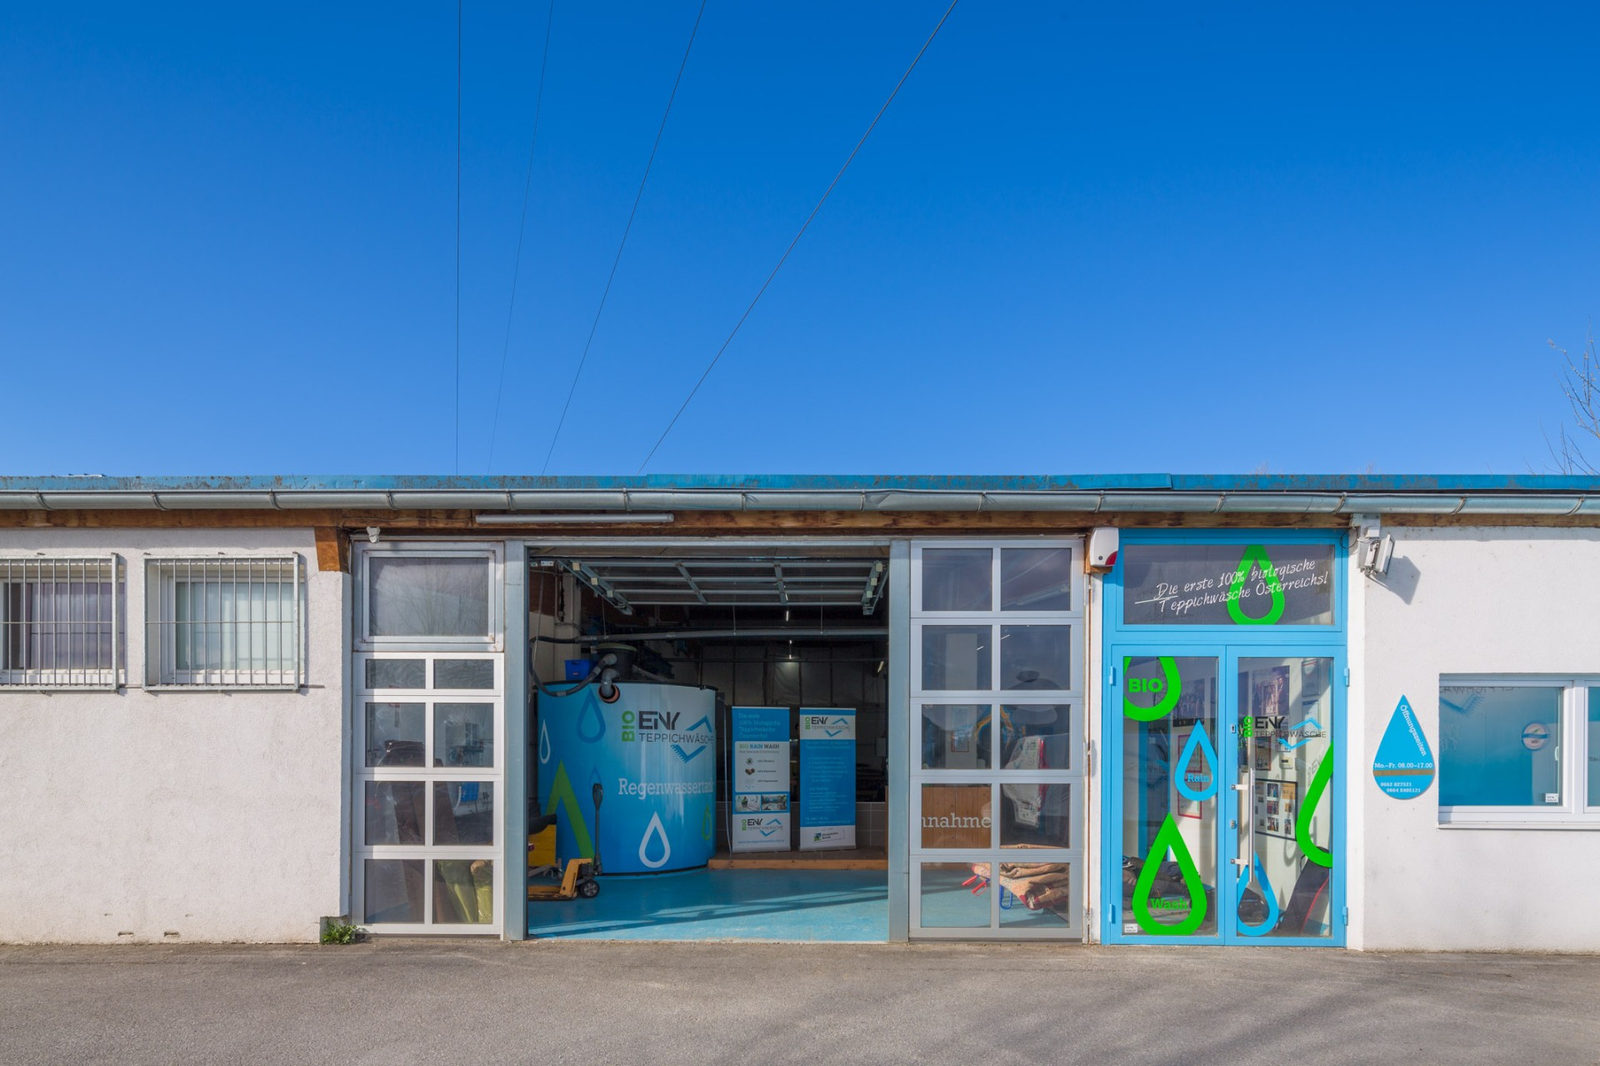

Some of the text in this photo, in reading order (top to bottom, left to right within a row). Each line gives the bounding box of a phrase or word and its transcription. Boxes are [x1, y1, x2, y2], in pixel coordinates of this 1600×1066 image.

[1153, 559, 1316, 600] Die erste 100% biologische
[1256, 571, 1329, 596] Österreichs!
[1127, 678, 1163, 693] BIO
[622, 710, 635, 742] BIO
[617, 777, 713, 800] Regenwassert
[1187, 773, 1210, 783] Rain
[1150, 897, 1188, 910] Wash
